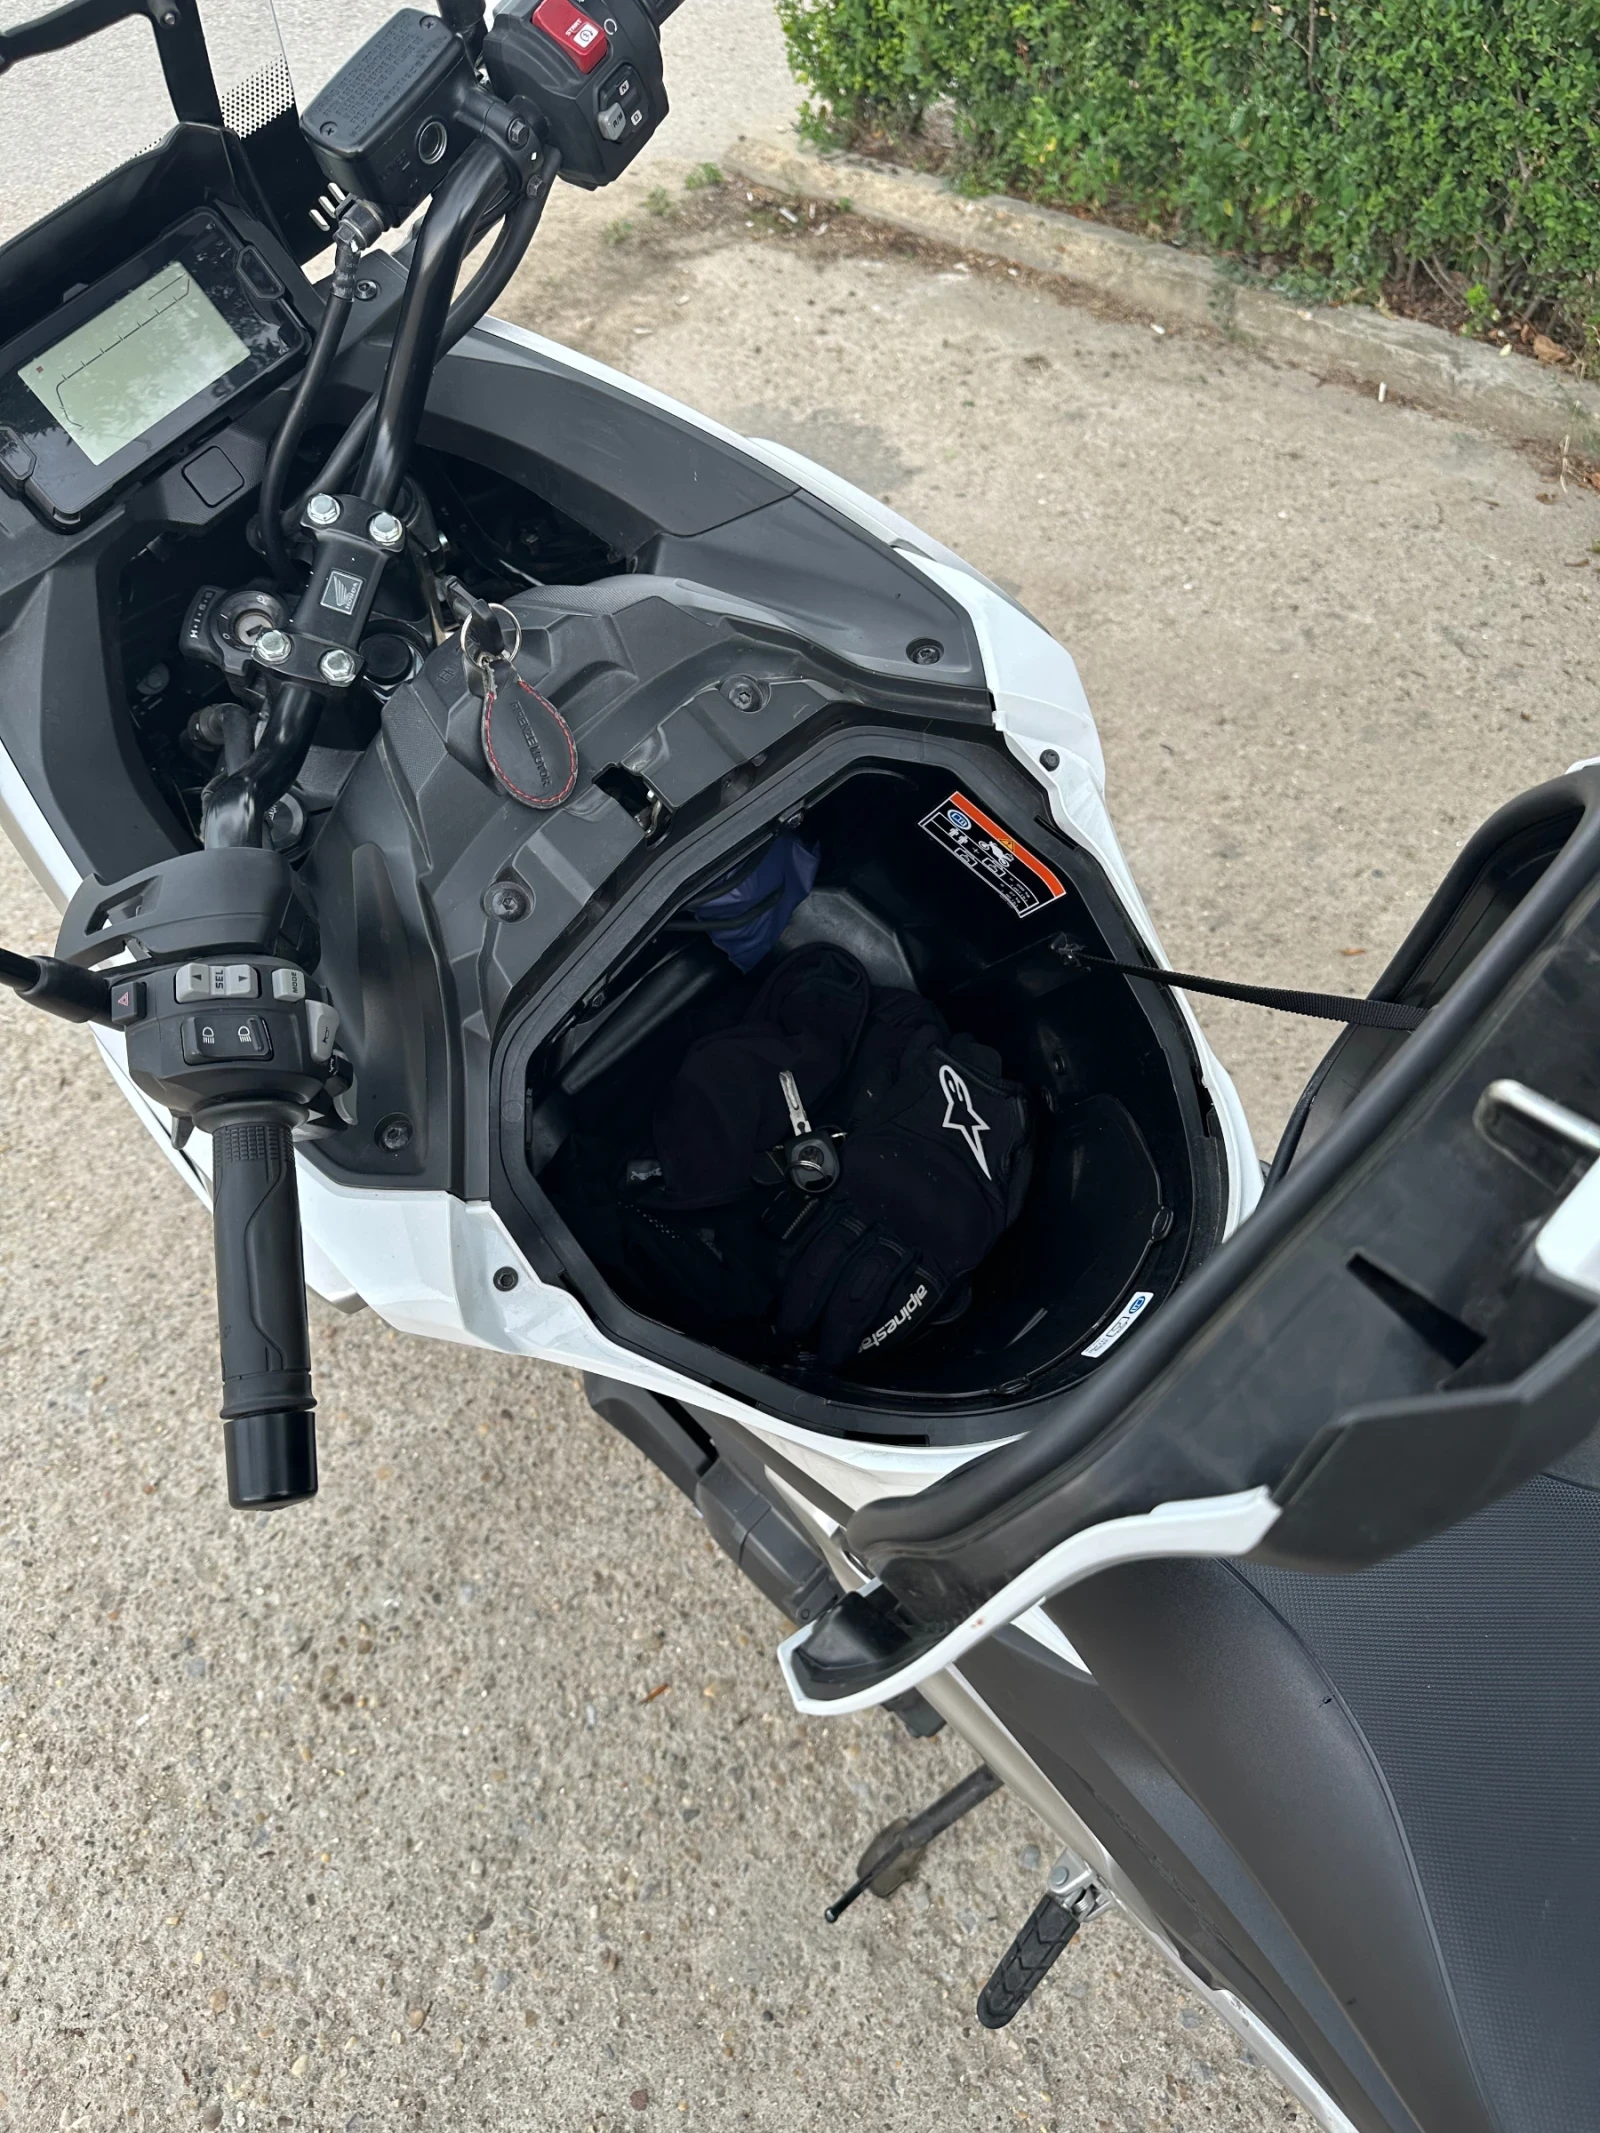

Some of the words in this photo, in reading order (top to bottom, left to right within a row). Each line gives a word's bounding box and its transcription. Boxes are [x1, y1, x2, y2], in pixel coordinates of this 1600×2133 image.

[565, 18, 583, 37] START
[345, 582, 359, 610] HONDA
[215, 970, 224, 989] SEL
[291, 971, 299, 994] MODE
